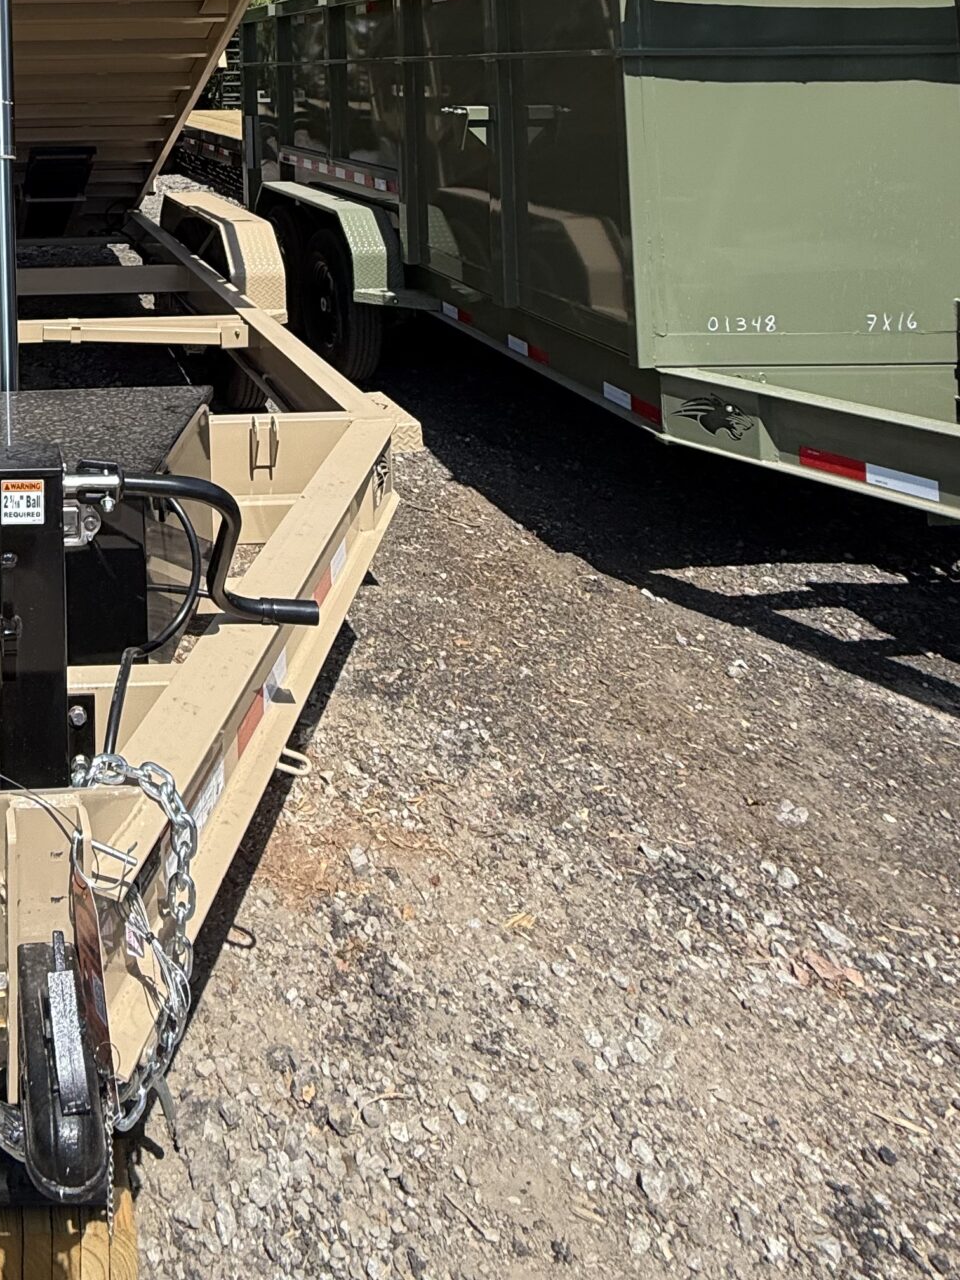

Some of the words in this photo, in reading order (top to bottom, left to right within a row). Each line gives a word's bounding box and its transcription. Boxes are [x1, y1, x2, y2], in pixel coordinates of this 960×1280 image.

[707, 314, 777, 332] 01348
[10, 482, 41, 490] WARNING
[26, 495, 41, 509] Ball
